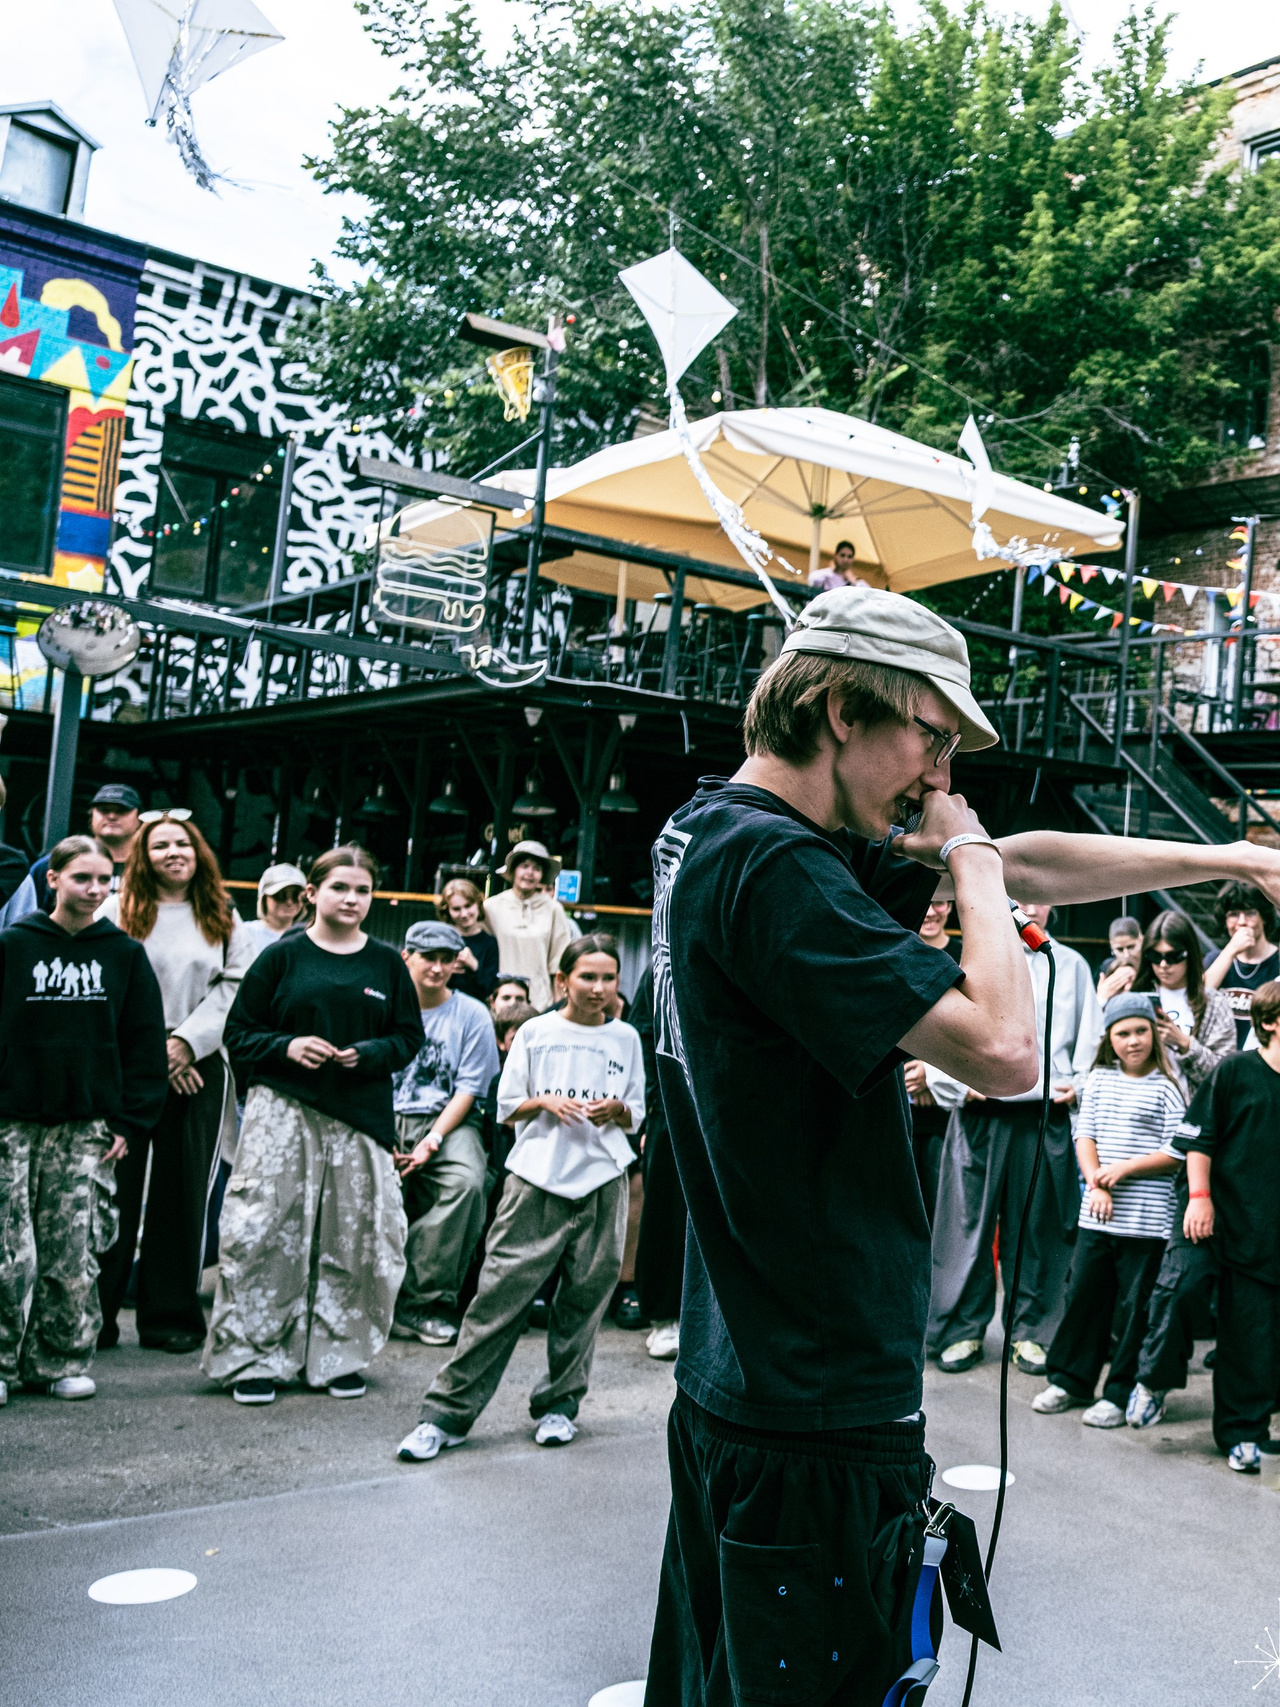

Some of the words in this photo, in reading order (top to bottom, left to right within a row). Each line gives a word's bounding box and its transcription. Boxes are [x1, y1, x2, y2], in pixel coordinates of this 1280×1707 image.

[536, 1088, 620, 1101] OOKLY
[834, 1577, 843, 1587] M
[779, 1659, 786, 1668] A
